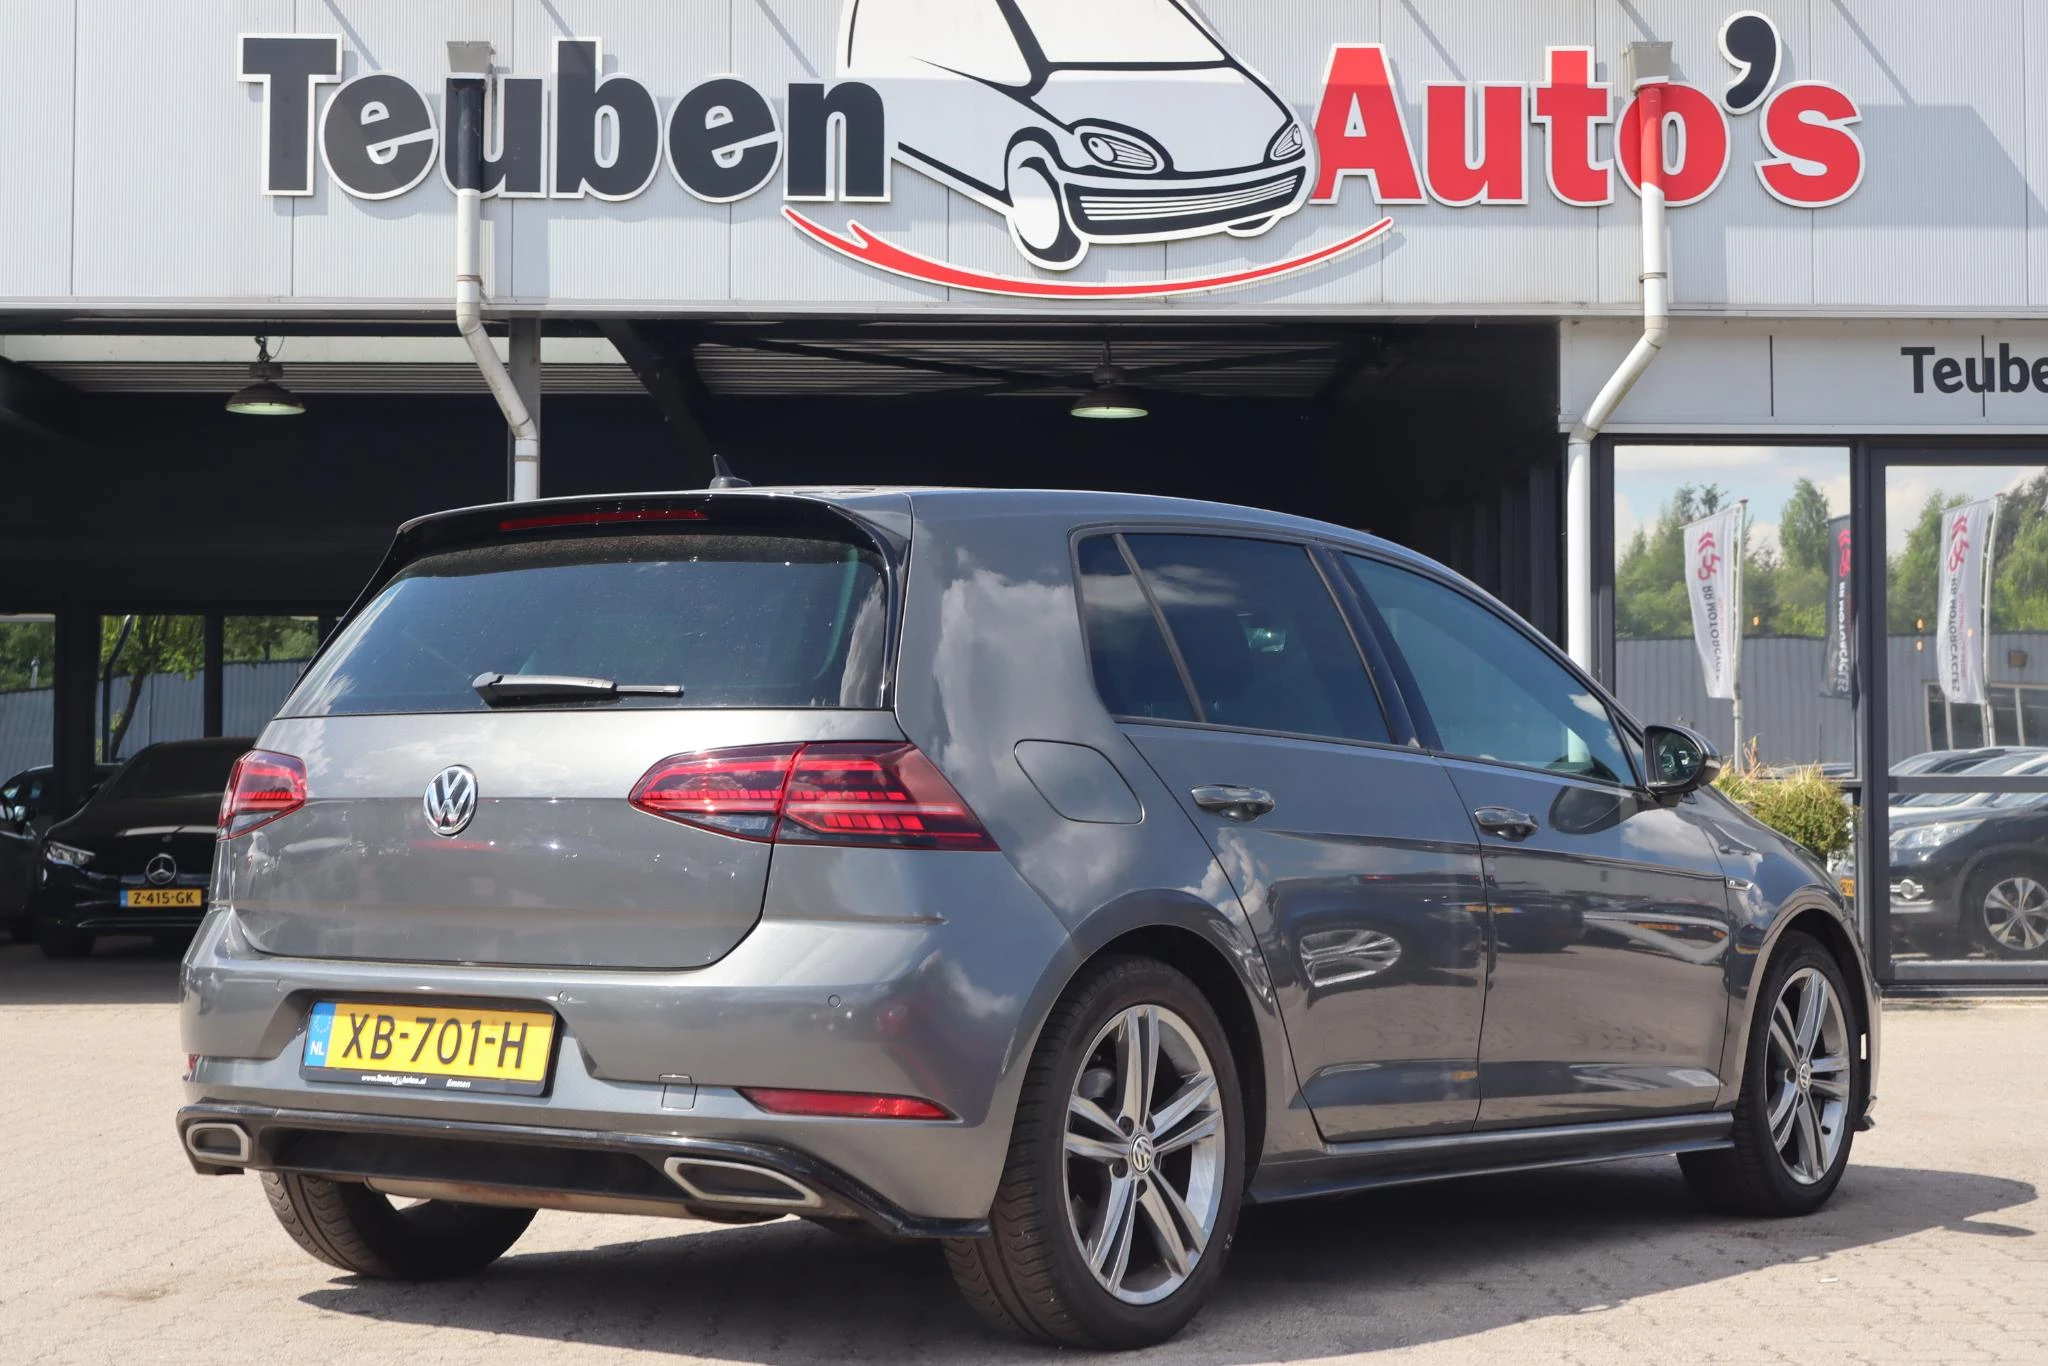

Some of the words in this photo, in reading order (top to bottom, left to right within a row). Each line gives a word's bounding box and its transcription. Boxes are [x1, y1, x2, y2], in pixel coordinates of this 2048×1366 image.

[240, 35, 888, 202] Teuben
[1309, 11, 1864, 206] Auto's
[310, 1040, 325, 1056] NL
[341, 1013, 529, 1069] XB-701-H
